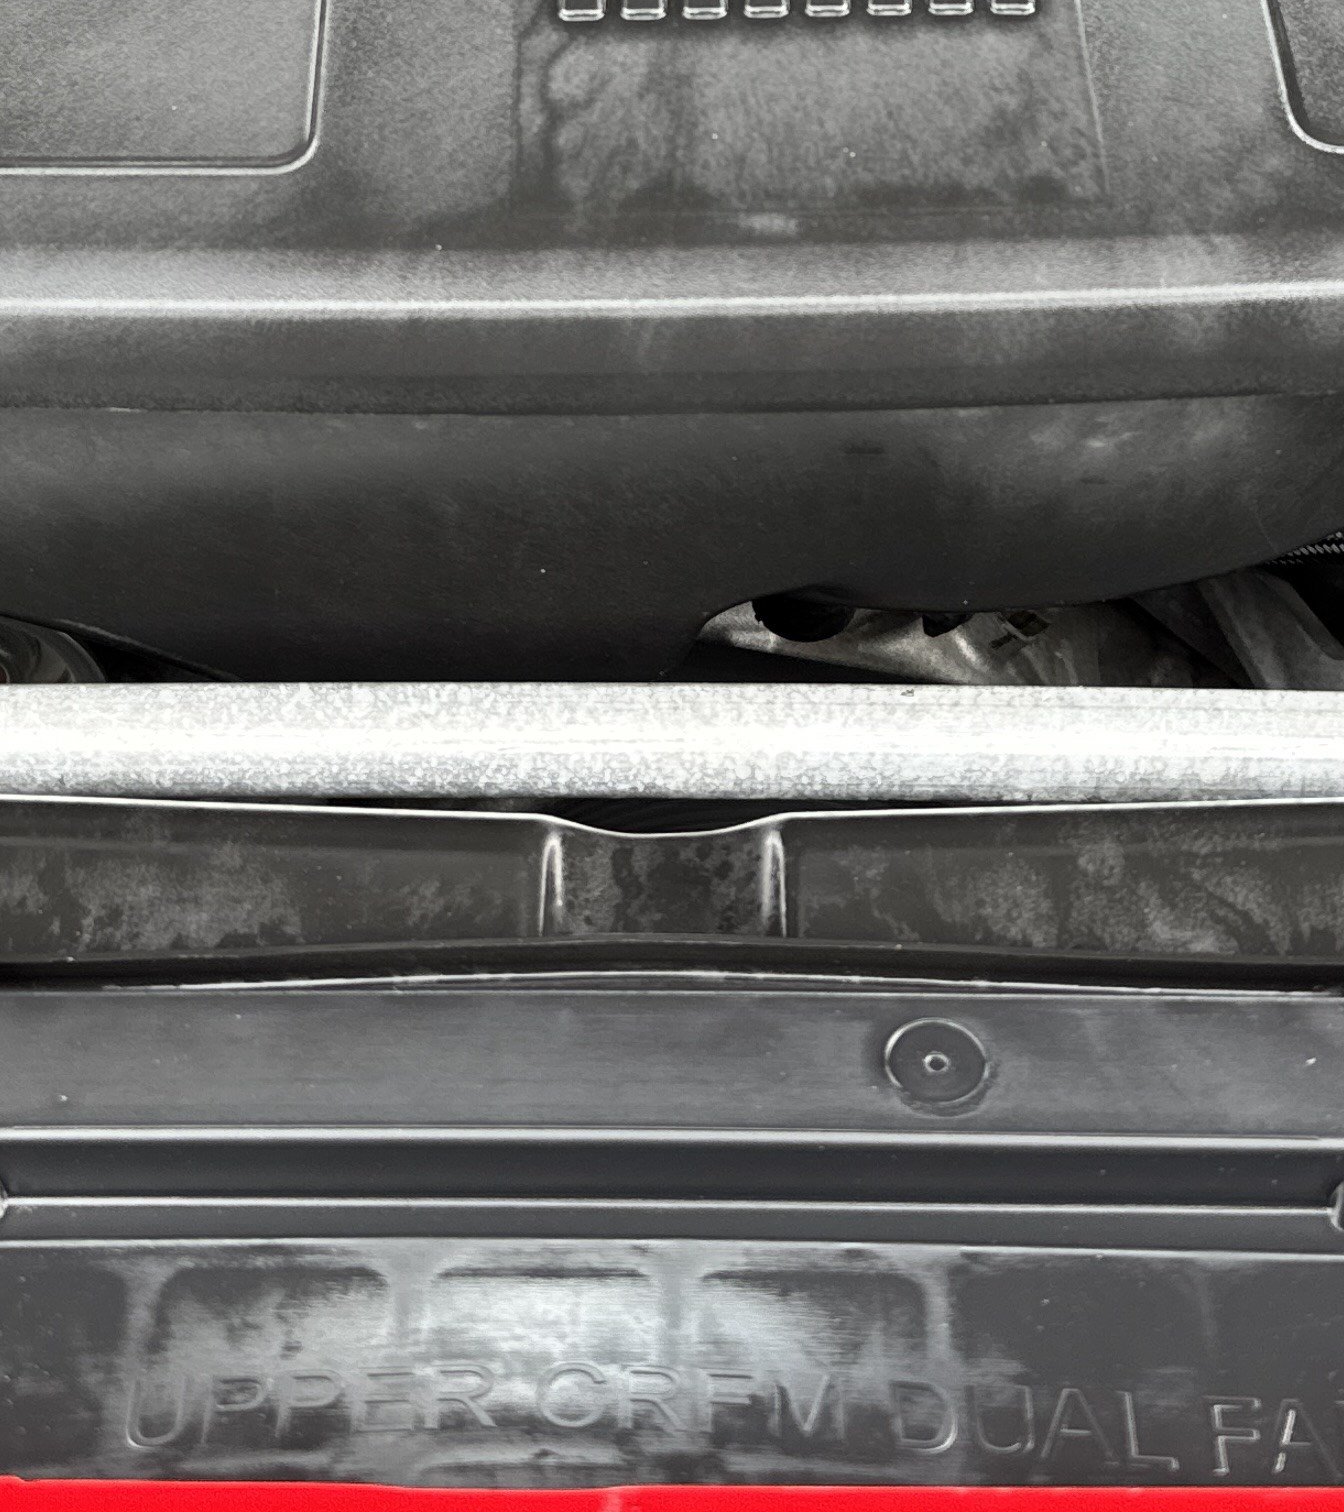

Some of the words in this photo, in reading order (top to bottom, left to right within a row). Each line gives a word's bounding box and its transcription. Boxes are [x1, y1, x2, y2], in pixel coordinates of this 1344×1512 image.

[125, 1360, 498, 1449] UPPER
[536, 1360, 846, 1443] CRFM
[887, 1378, 1181, 1473] DUAL
